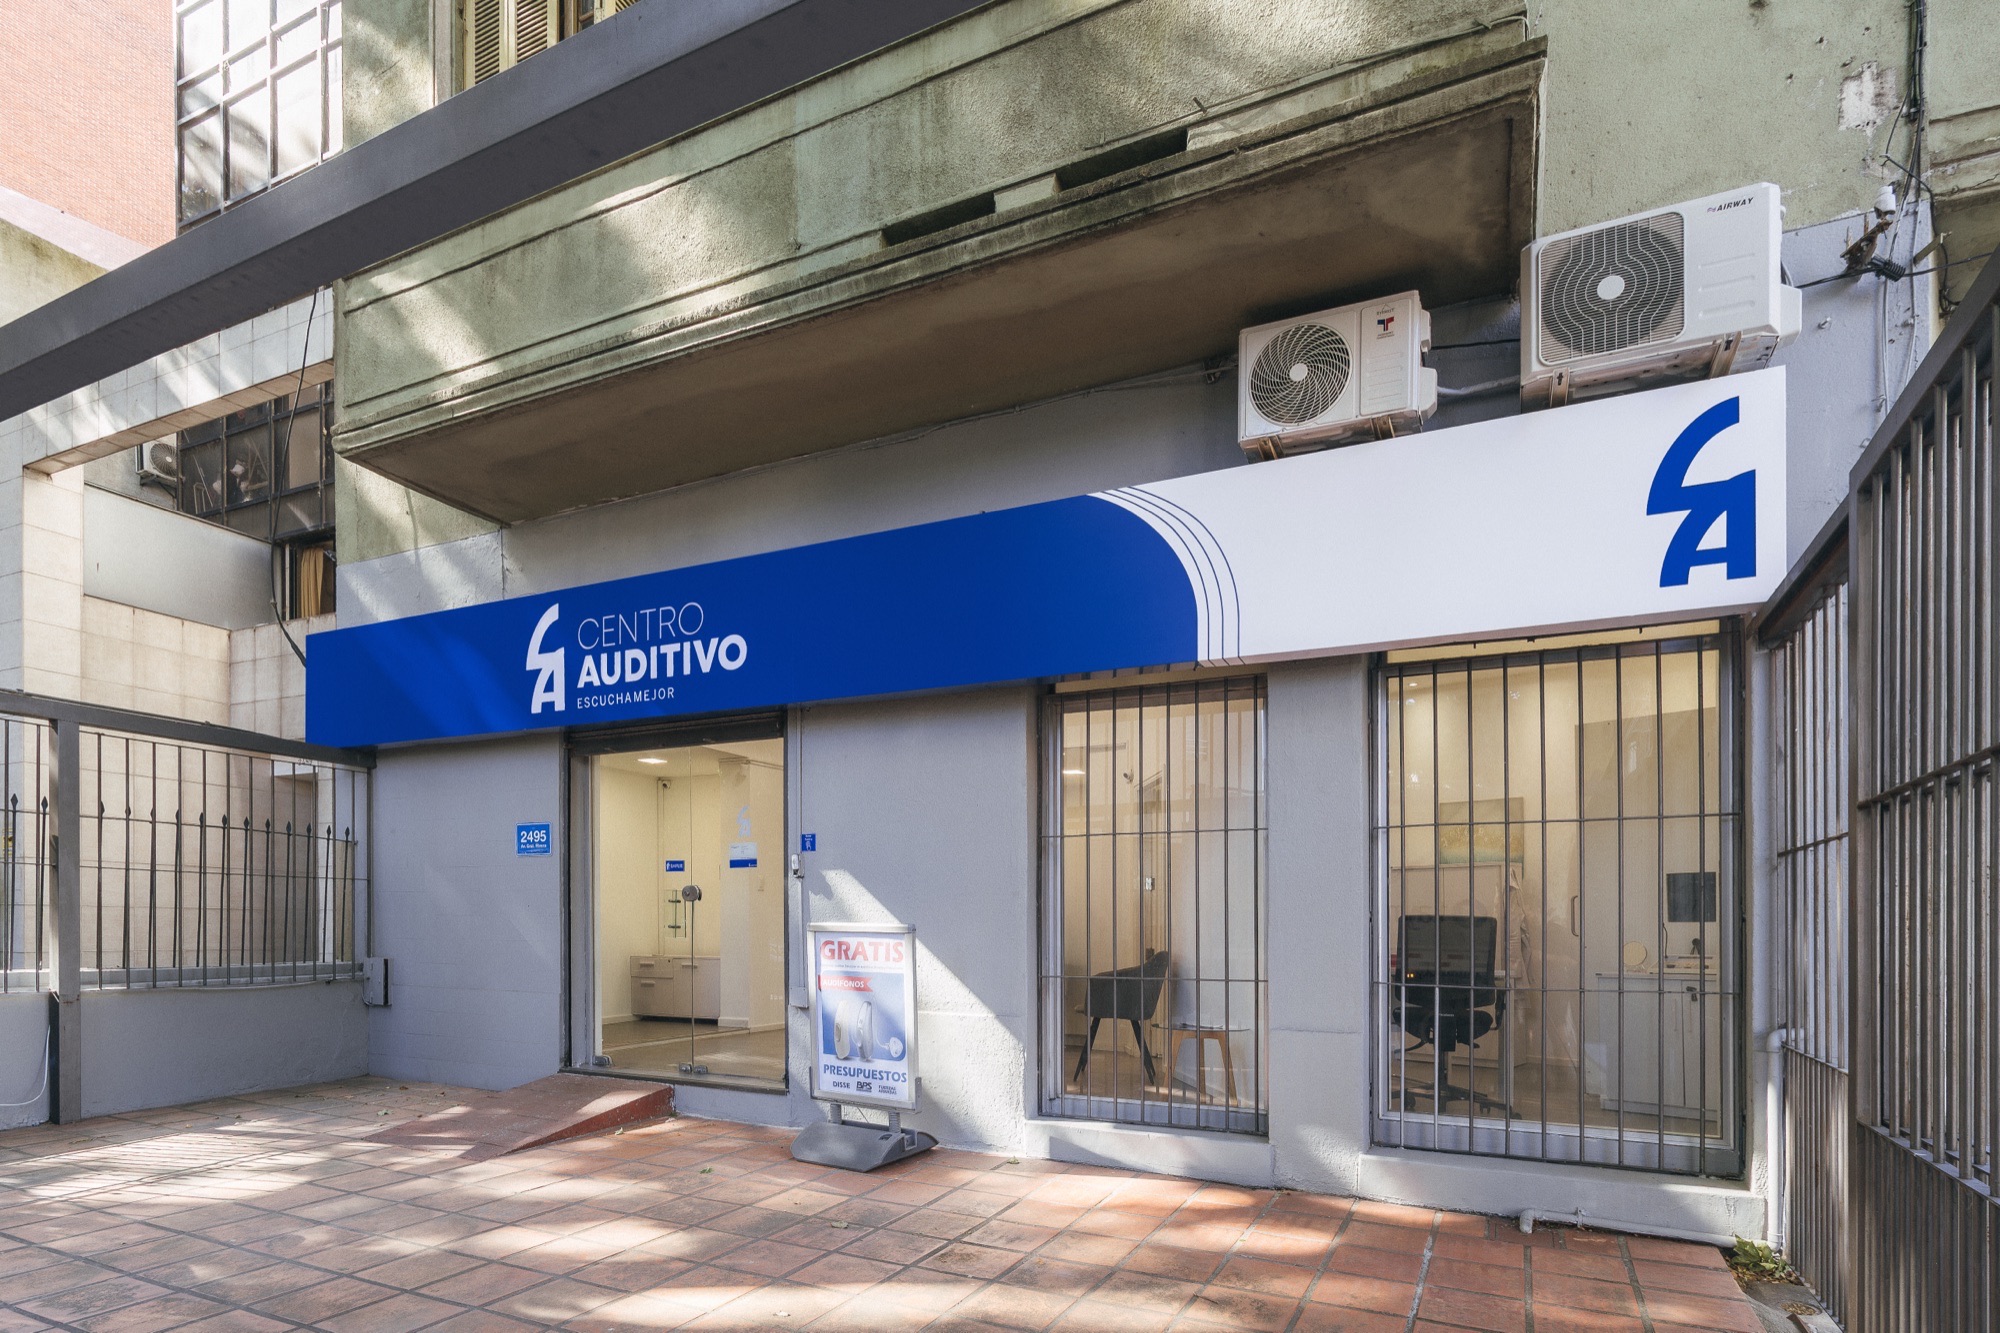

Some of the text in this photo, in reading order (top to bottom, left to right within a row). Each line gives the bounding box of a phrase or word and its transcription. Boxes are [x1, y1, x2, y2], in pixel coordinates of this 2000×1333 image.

[1717, 197, 1754, 212] AIRWAY
[577, 602, 704, 650] CENTRO
[577, 634, 748, 689] AUDITIVO
[577, 687, 675, 709] ESCUCHAMEJOR
[520, 830, 547, 843] 2495
[820, 940, 904, 963] GRATIS
[822, 978, 865, 988] AUDÍFONOS
[823, 1064, 907, 1083] PRESUPUESTOS
[832, 1080, 872, 1090] DISSE BPS
